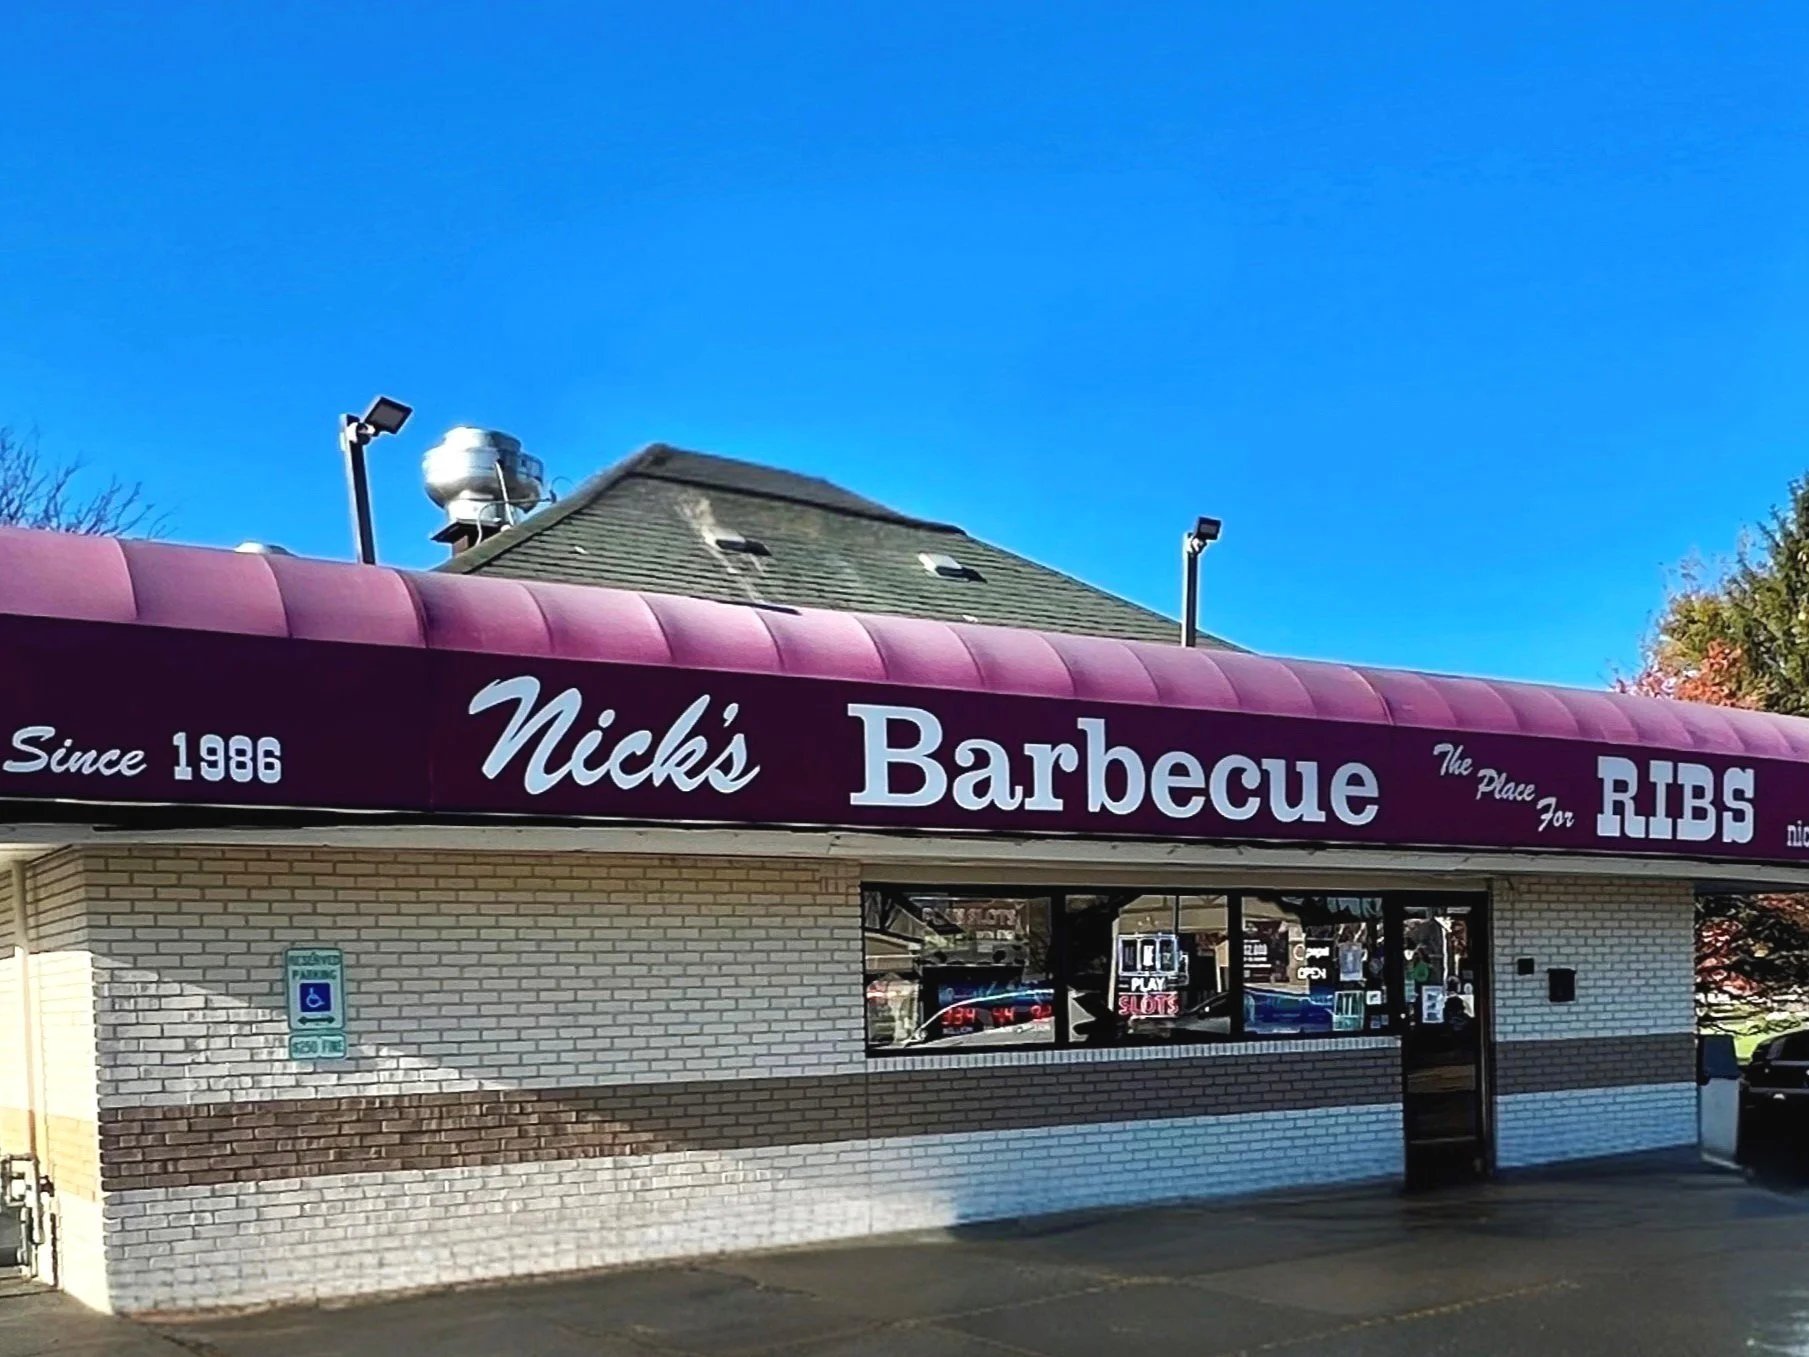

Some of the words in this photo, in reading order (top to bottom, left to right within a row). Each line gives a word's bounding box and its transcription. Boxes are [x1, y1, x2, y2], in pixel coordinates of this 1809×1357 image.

[2, 726, 147, 776] Since
[172, 732, 282, 783] 1986
[468, 676, 761, 796] Nick's
[847, 703, 1381, 826] Barbecue
[1433, 743, 1473, 775] The
[1476, 768, 1535, 801] Place
[1536, 797, 1575, 832] For
[1597, 756, 1755, 844] RIBS
[1118, 994, 1179, 1015] SLOTS
[1131, 977, 1165, 993] PLAY
